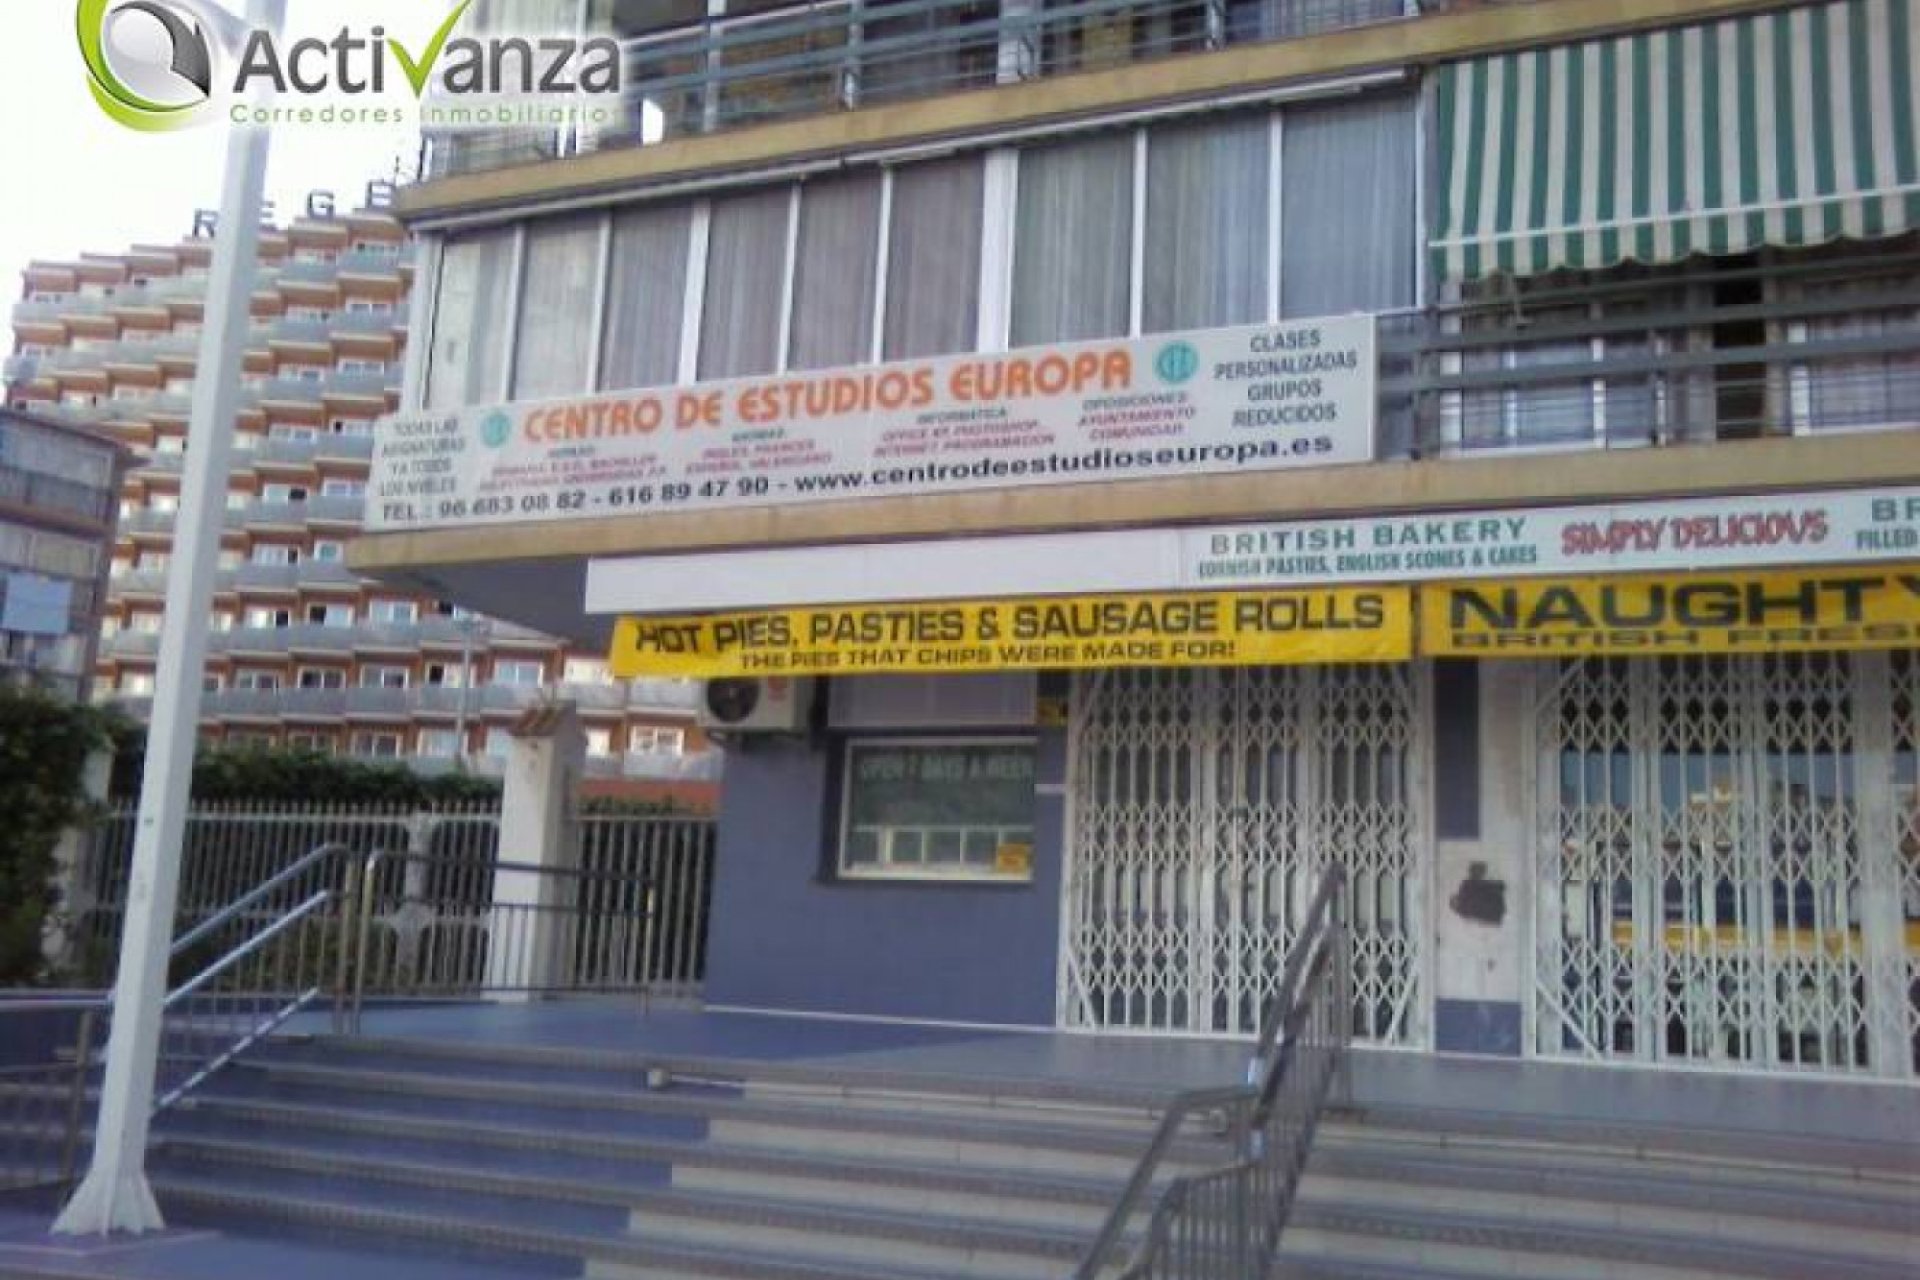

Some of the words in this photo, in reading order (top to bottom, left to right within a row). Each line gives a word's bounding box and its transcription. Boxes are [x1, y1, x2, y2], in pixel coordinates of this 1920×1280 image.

[1250, 329, 1320, 352] CLASES
[1214, 350, 1358, 380] PERSONALIZADAS
[524, 397, 662, 442] CENTRO
[675, 391, 722, 429] DE
[736, 366, 933, 422] ESTUDIOS
[949, 349, 1131, 403] EUROPA
[1247, 378, 1321, 401] GRUPOS
[1231, 402, 1336, 427] REDUCIDOS
[1211, 527, 1355, 555] BRITISH
[1372, 516, 1526, 546] BAKERY
[1561, 515, 1668, 556] SIMPLY
[635, 622, 704, 654] HOT
[810, 610, 963, 646] PASTIES
[976, 606, 999, 640] &
[1013, 600, 1220, 637] SAUSAGE
[1235, 594, 1384, 632] ROLLS
[741, 652, 788, 669] THE
[791, 650, 841, 667] PIES
[848, 648, 909, 666] THAT
[917, 647, 992, 664] CHIPS
[998, 644, 1077, 663] WERE
[1082, 642, 1162, 661] MADE
